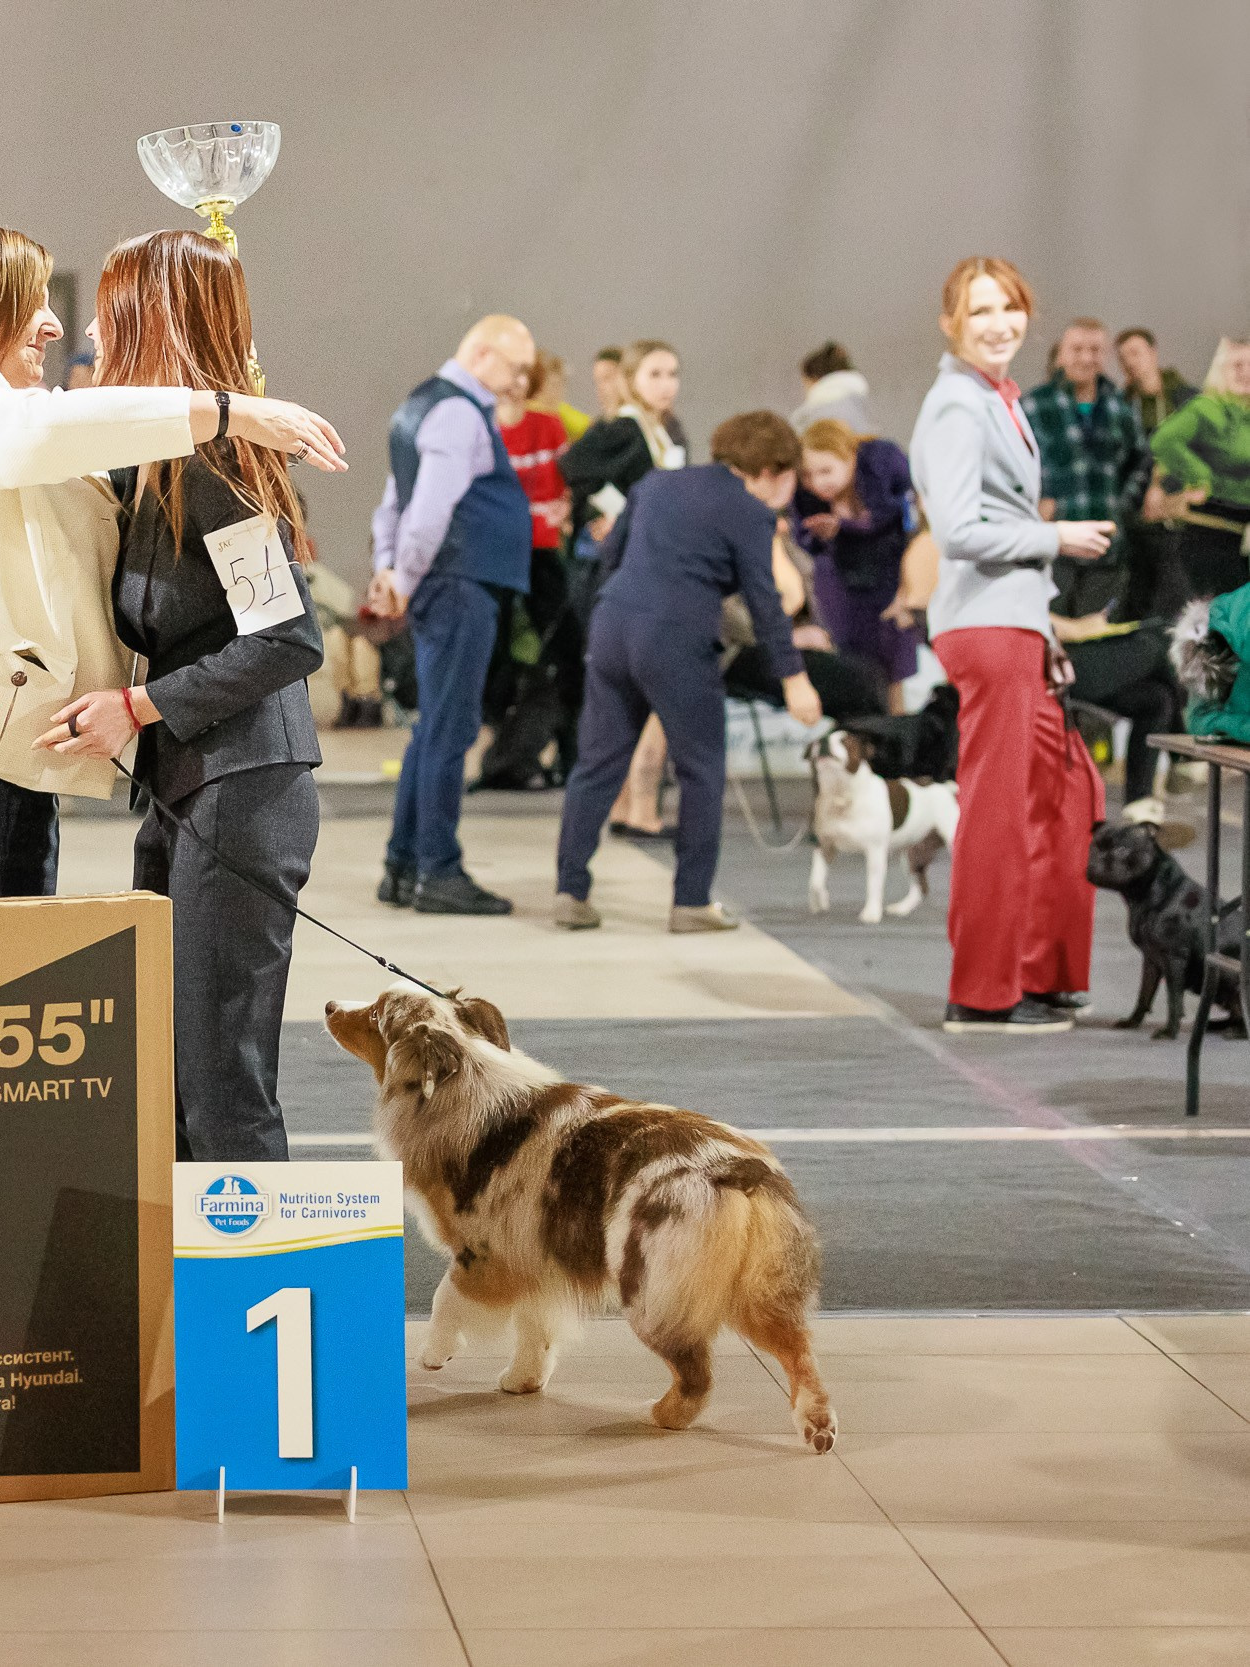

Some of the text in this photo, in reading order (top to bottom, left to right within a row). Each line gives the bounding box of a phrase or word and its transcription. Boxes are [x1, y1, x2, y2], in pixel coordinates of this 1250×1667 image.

[230, 545, 287, 615] 51
[81, 1077, 112, 1099] TV
[200, 1197, 264, 1213] Farmina
[279, 1192, 380, 1206] Nutrition System
[280, 1207, 367, 1218] for Carnivores
[214, 1218, 250, 1227] Pet Foods
[10, 1368, 83, 1390] Hyundai.
[246, 1287, 313, 1459] 1
